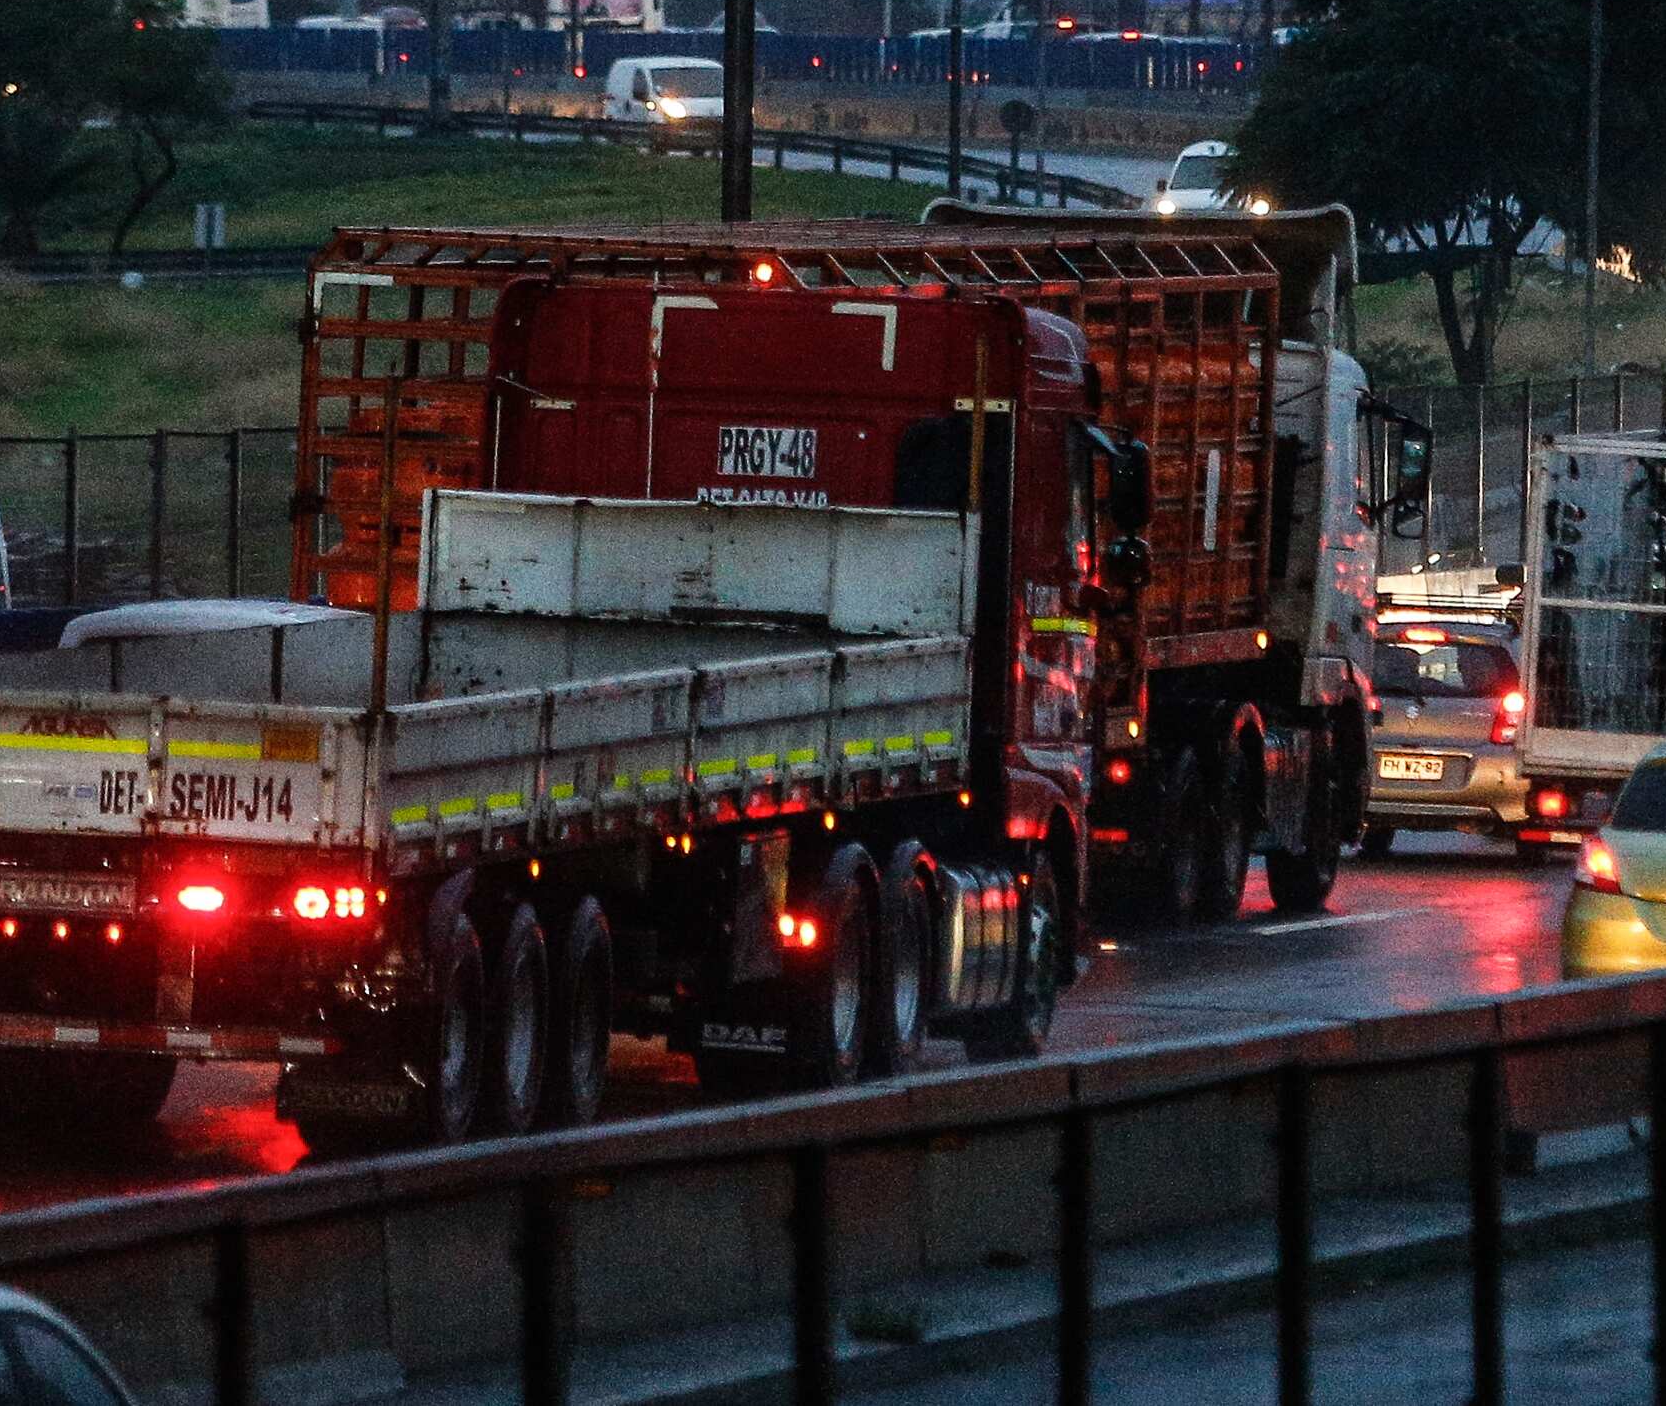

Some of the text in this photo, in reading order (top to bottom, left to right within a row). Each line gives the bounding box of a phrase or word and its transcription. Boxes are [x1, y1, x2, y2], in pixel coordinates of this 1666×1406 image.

[719, 429, 814, 475] PRGY-48
[171, 774, 293, 821] SEMI-J14
[701, 1022, 788, 1044] DAF
